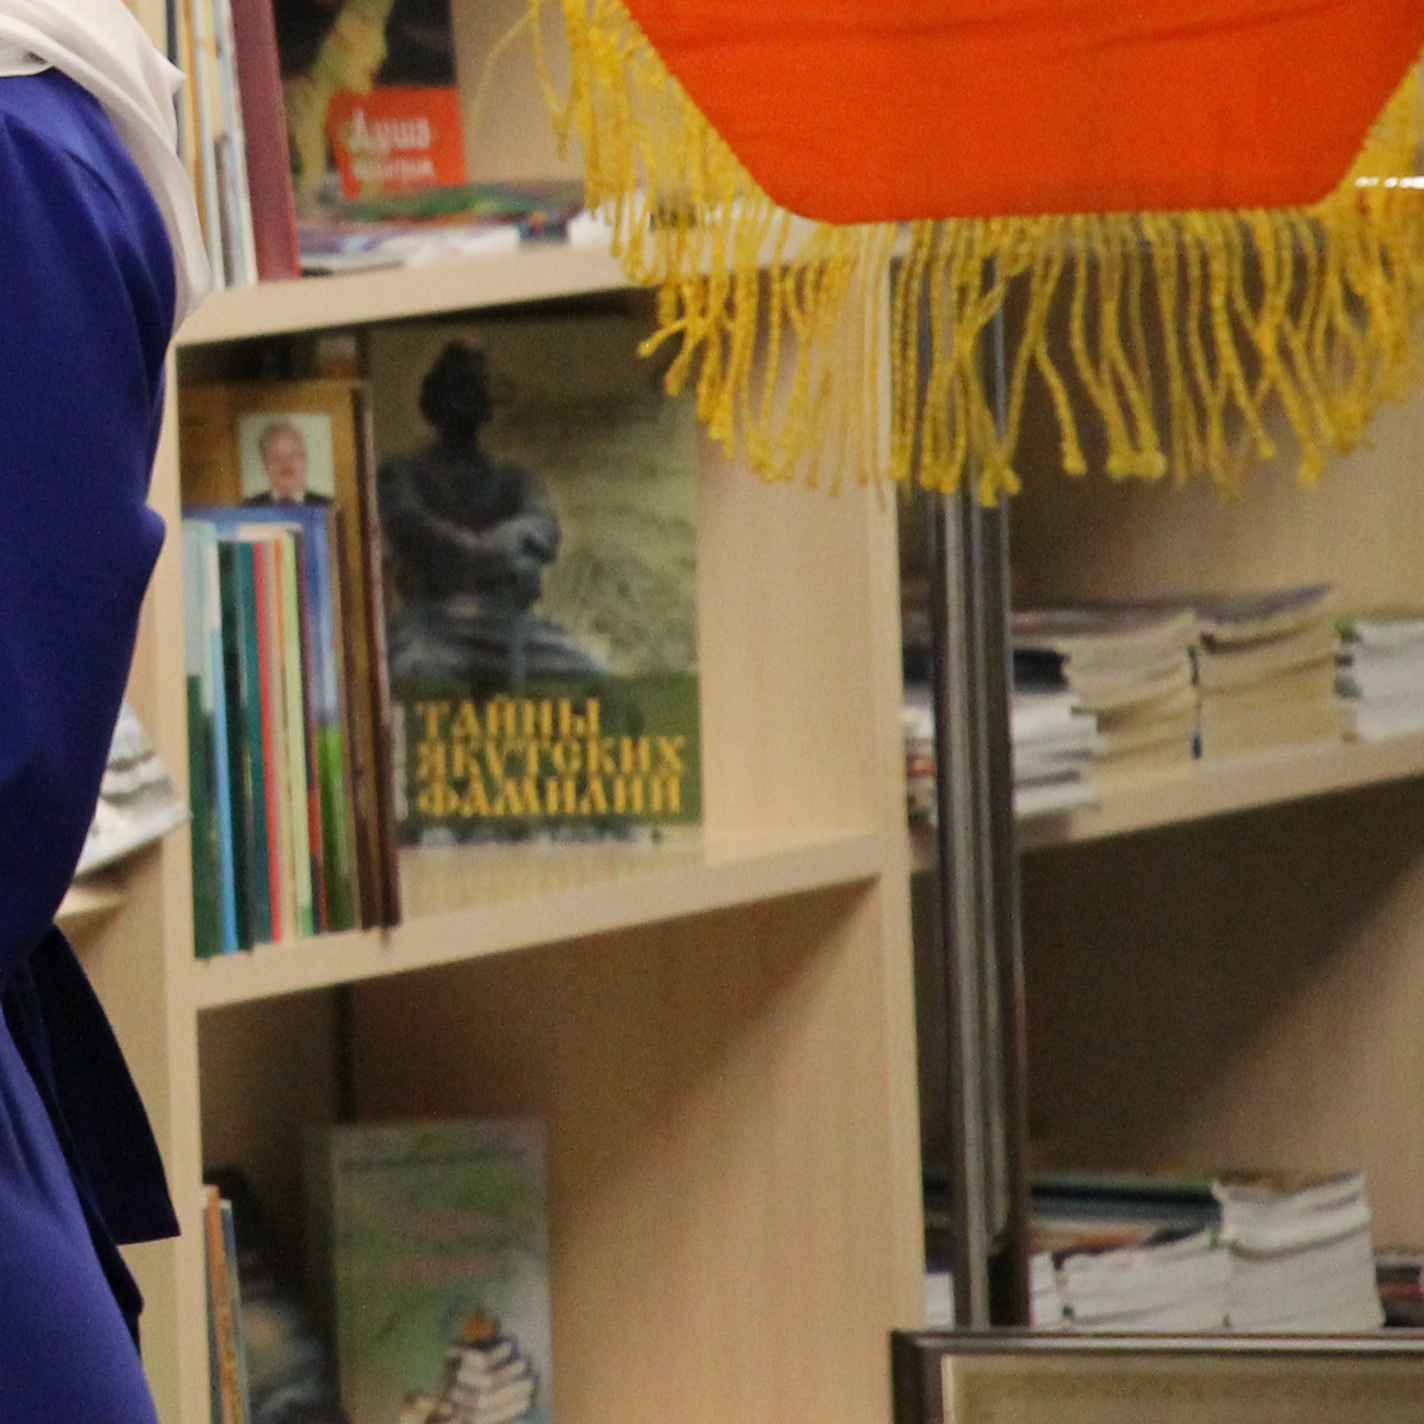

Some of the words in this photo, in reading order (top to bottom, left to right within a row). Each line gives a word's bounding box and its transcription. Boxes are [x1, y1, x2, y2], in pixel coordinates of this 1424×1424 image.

[416, 694, 601, 740] ТАЙНЫ
[415, 736, 686, 778] ЯКУТСКИХ
[414, 770, 683, 817] ФАМИЛИЙ
